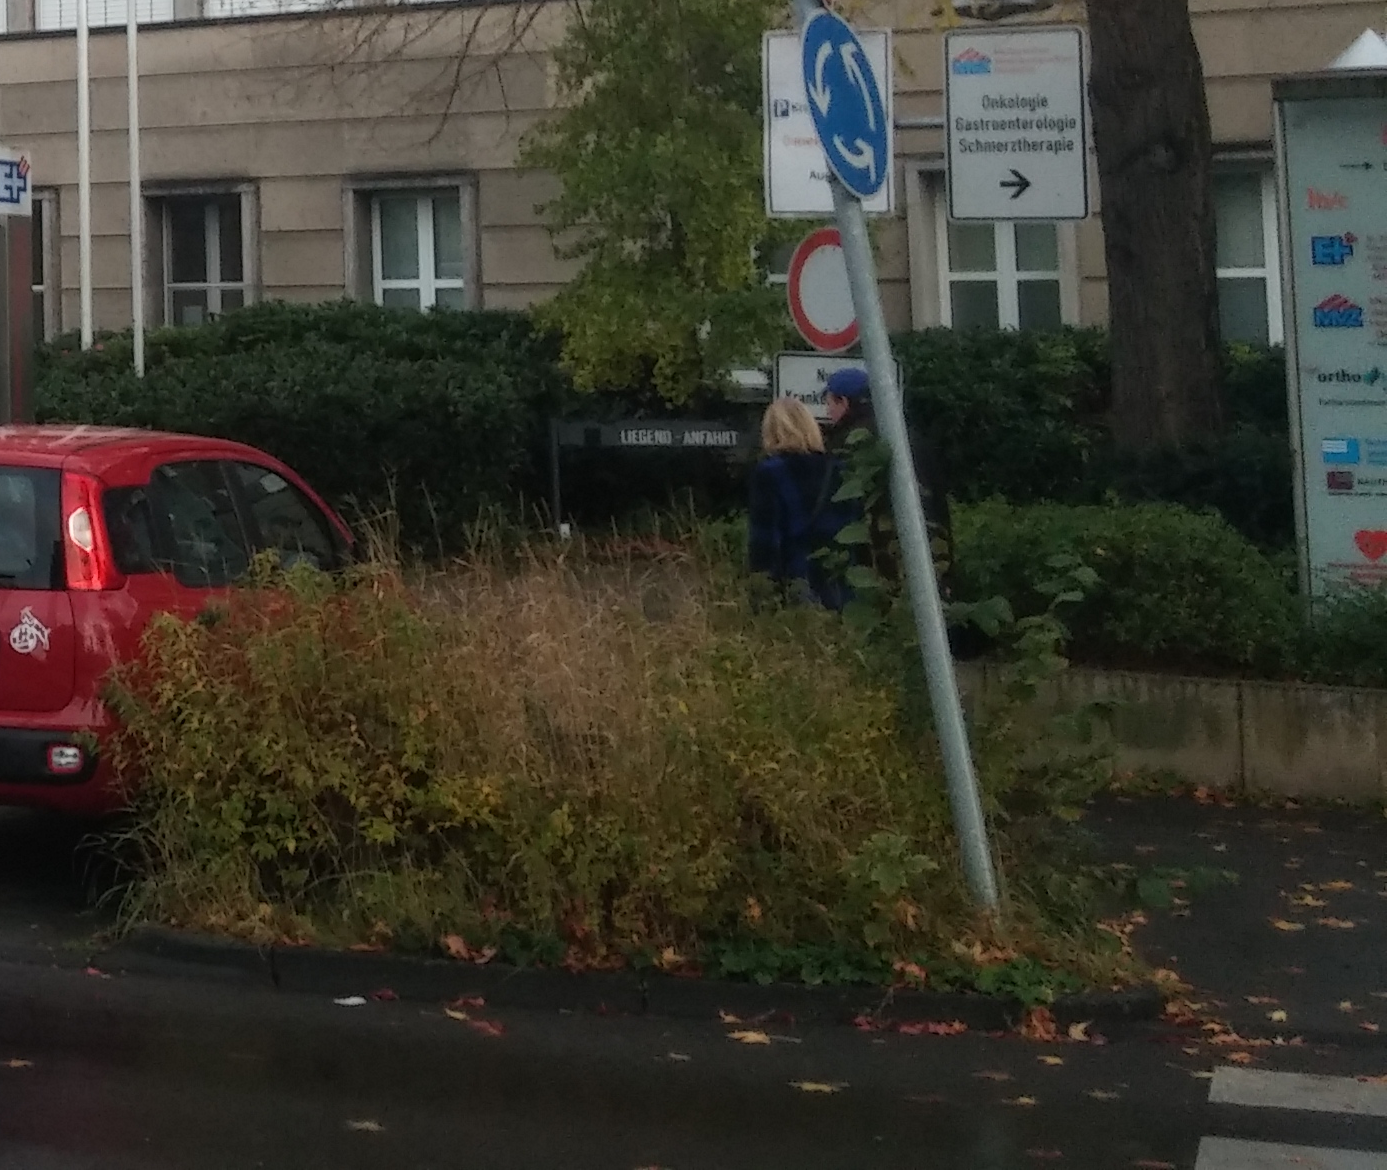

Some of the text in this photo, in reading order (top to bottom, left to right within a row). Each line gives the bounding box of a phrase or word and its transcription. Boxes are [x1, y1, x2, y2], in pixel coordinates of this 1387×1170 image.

[981, 94, 1048, 111] Onkologie
[955, 114, 1077, 132] Gastroenterologie
[958, 137, 1075, 155] Schmerztherapie
[1318, 369, 1361, 383] ortho
[620, 429, 672, 445] LIEGEND
[682, 429, 738, 446] ANFAHRT
